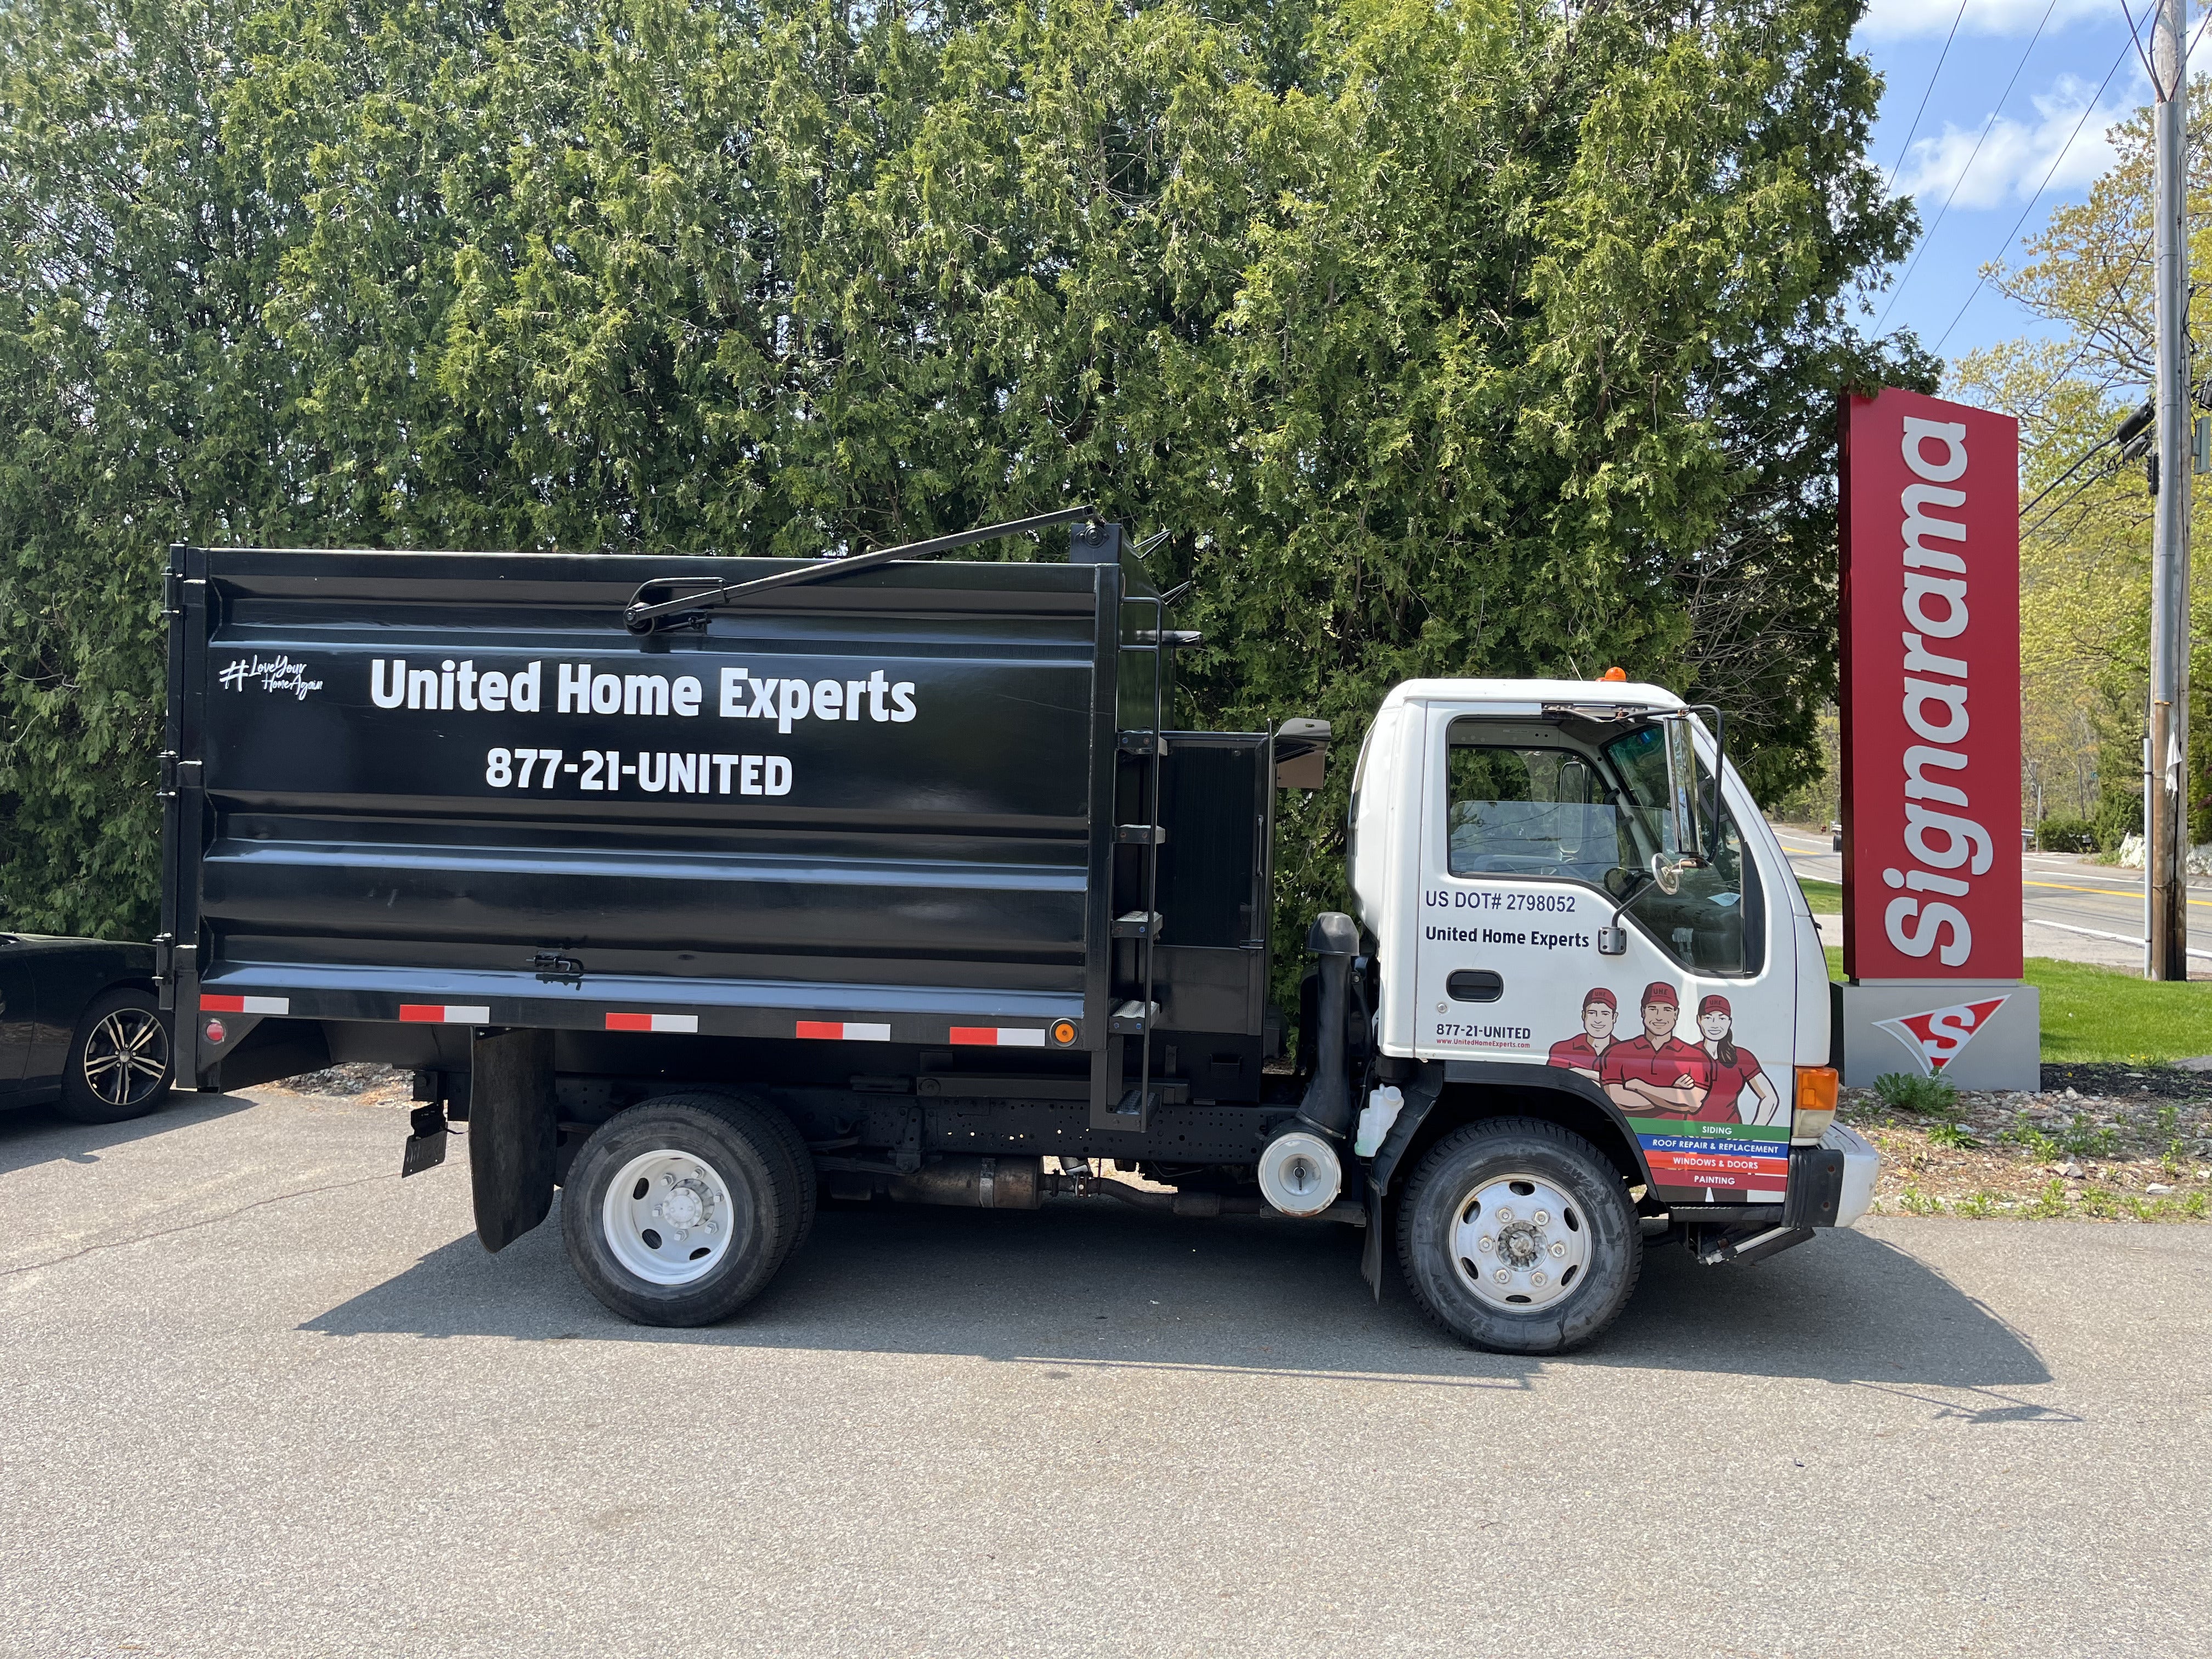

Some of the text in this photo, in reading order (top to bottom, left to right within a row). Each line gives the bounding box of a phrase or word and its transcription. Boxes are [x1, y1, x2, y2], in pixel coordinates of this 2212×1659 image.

[370, 659, 917, 734] United Home Experts
[1882, 416, 1993, 967] Signarama
[486, 747, 793, 796] 877-21-UNITED
[1426, 890, 1575, 912] US DOT# 2798052
[1426, 926, 1589, 950] United Home Experts
[1653, 988, 1668, 996] UHE
[1436, 1024, 1531, 1040] 877-21-UNITED
[1436, 1039, 1530, 1048] www.UnitedHomeExperts.com
[1702, 1126, 1733, 1135] SIDING
[1652, 1139, 1677, 1147] ROOF
[1679, 1141, 1708, 1149] REPAIR
[1718, 1143, 1779, 1154] REPLACEMENT
[1673, 1157, 1716, 1167] WINDOWS
[1727, 1160, 1759, 1170] DOORS
[1694, 1175, 1735, 1185] PAINTING
